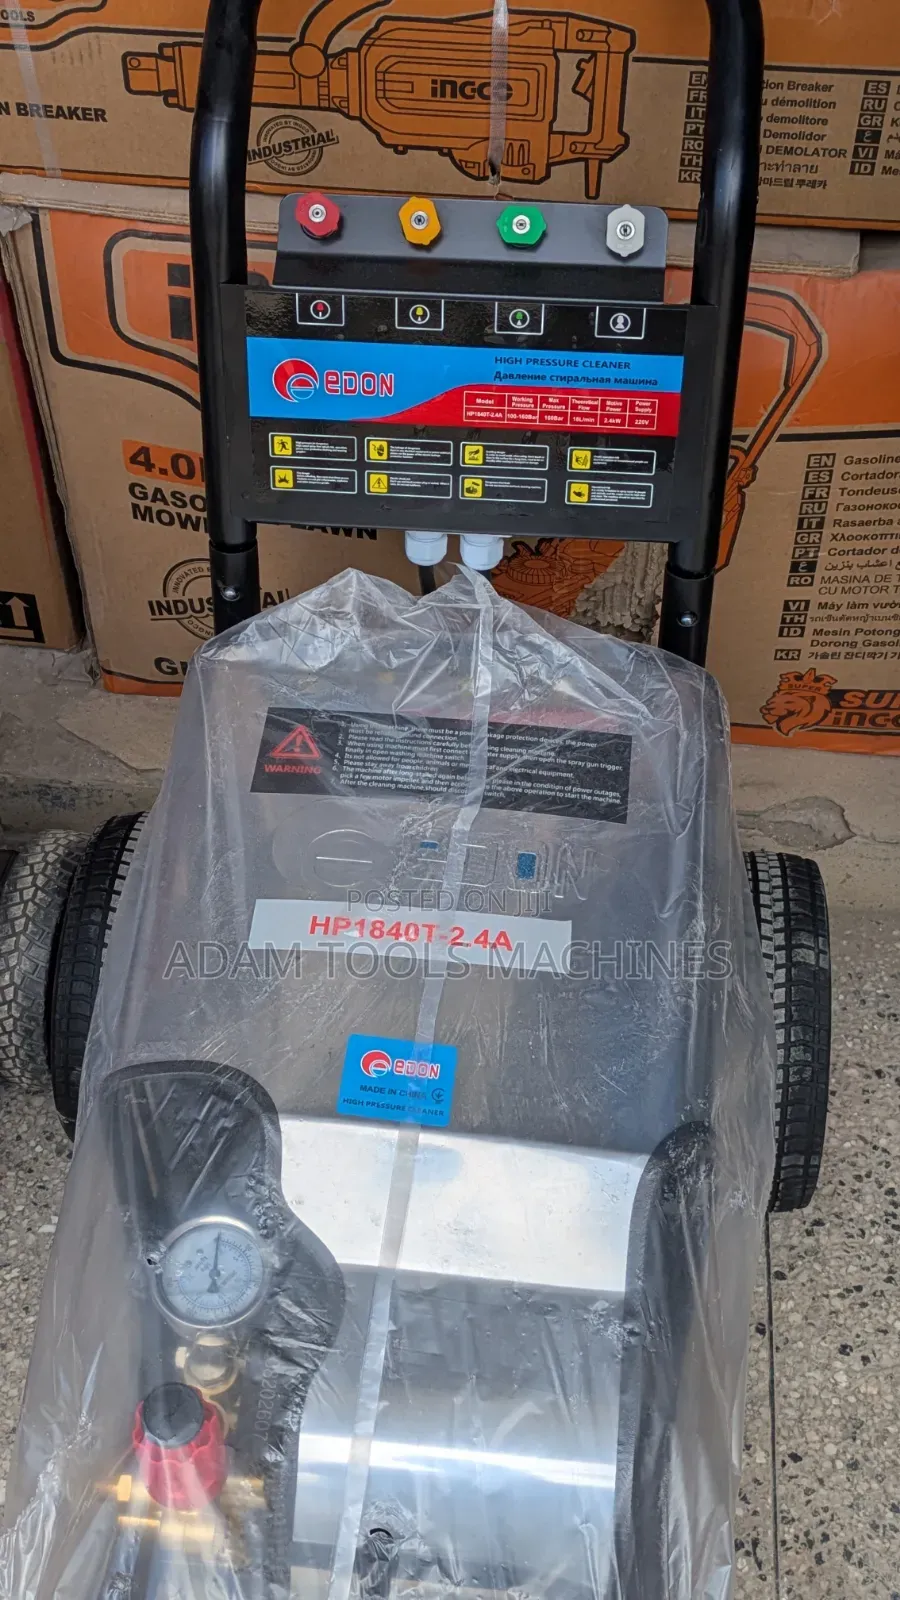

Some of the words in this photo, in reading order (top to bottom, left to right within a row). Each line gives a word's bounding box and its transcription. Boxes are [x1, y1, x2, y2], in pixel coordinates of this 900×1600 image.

[787, 80, 834, 93] Breaker
[771, 96, 837, 109] démolition
[16, 102, 108, 123] BREAKER
[766, 113, 829, 126] demolitore
[763, 129, 827, 141] Demolidor
[248, 130, 336, 162] INDUSTRIAL
[766, 145, 848, 159] DEMOLATOR
[495, 356, 523, 366] HIGH
[526, 358, 579, 368] PRESSURE
[582, 360, 631, 370] CLEANER
[494, 371, 547, 382] Давление
[550, 374, 611, 384] стиральная
[614, 377, 658, 386] машина
[129, 446, 205, 482] 4.0
[128, 482, 208, 513] GASO
[833, 518, 893, 528] Rasaerba
[828, 546, 887, 557] Cortador
[172, 566, 204, 594] INNOVATED
[820, 575, 870, 584] MASINA
[874, 574, 893, 584] DE
[818, 586, 838, 596] CU
[841, 585, 890, 595] MOTOR
[818, 602, 843, 612] Máy
[847, 602, 869, 610] làm
[812, 628, 851, 637] Mesin
[854, 628, 900, 638] Potong
[810, 640, 858, 649] Dorong
[808, 652, 842, 660] 가솔린
[154, 657, 188, 676] G
[788, 684, 822, 692] SUPER
[506, 734, 539, 742] protection
[345, 747, 364, 755] finally
[390, 751, 416, 759] washing
[433, 741, 460, 749] carefully
[501, 746, 527, 754] cleaning
[264, 764, 323, 775] WARNING
[509, 766, 538, 774] electrical
[568, 760, 586, 768] spray
[369, 782, 396, 790] cleaning
[426, 785, 448, 793] should
[524, 788, 556, 796] operation
[533, 782, 564, 790] condition
[309, 915, 513, 952] HP1840T-2.4A
[360, 1084, 386, 1095] MADE
[399, 1090, 428, 1100] CHINA
[343, 1098, 365, 1107] HIGH
[366, 1100, 406, 1112] PRESSURE
[408, 1106, 445, 1117] CLEANER
